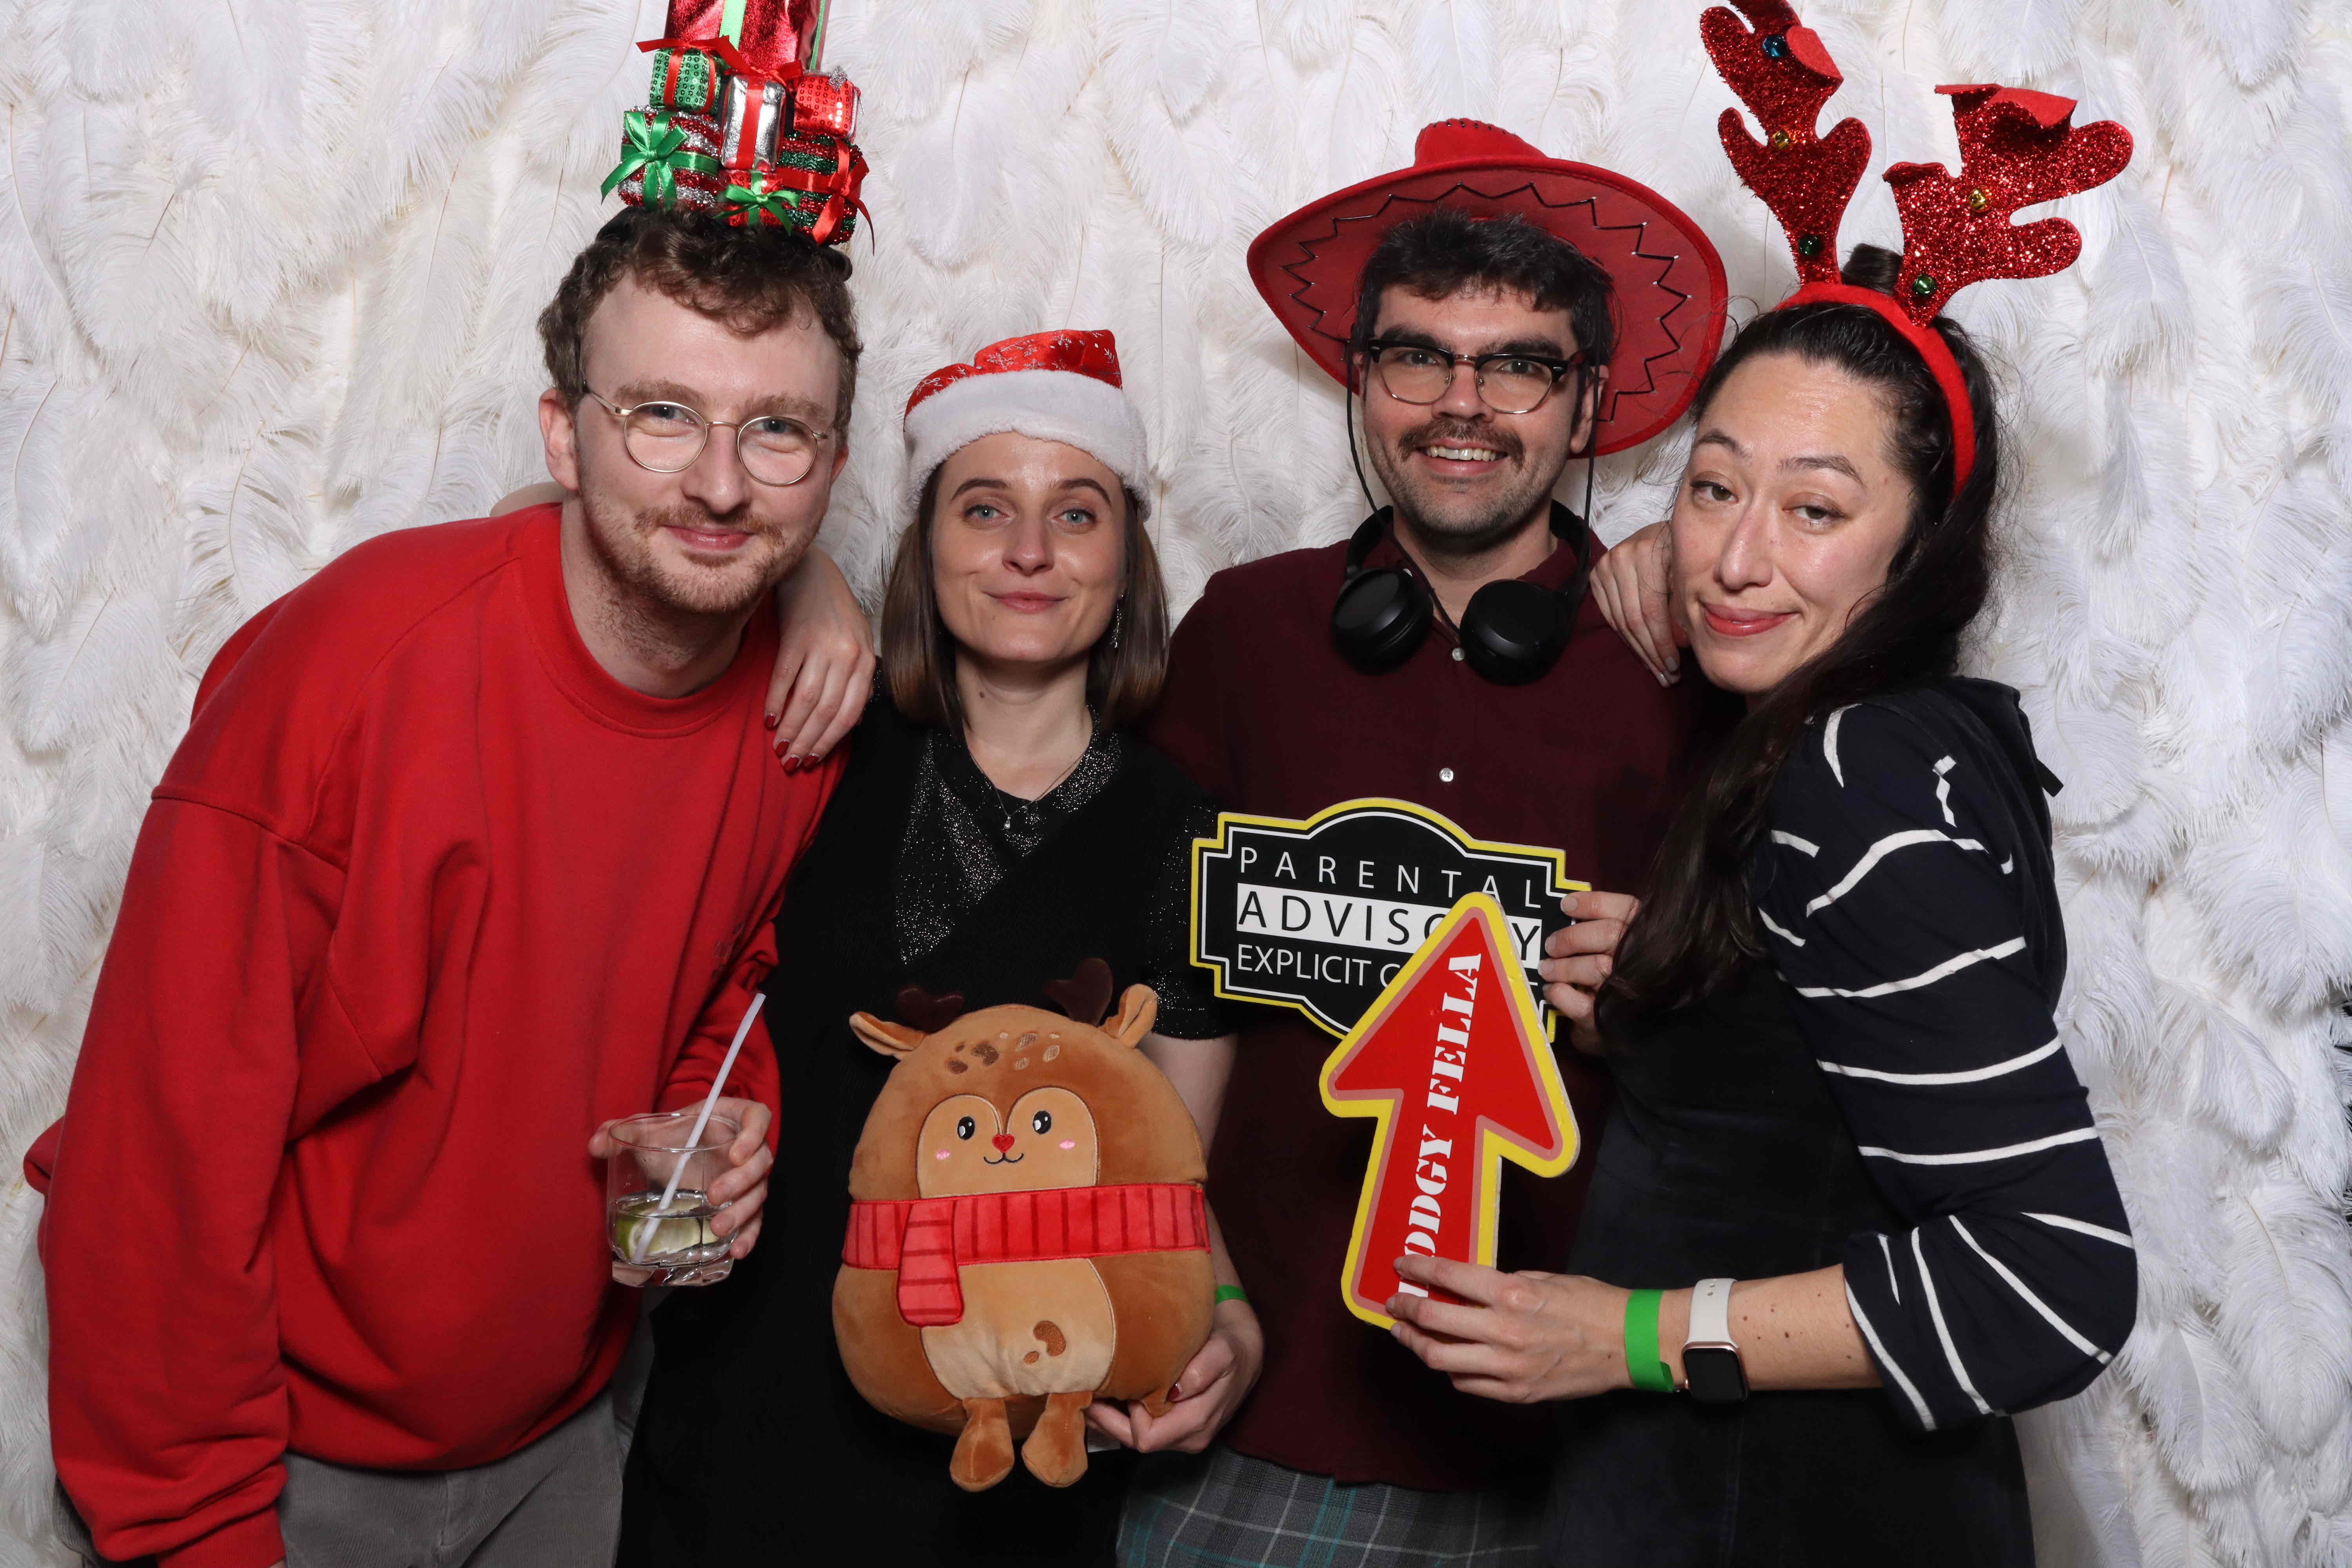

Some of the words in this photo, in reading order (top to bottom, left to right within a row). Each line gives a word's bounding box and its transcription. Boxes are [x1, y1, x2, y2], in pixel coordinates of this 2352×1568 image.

[1240, 846, 1541, 909] PARENTAL
[1238, 891, 1540, 961] ADVISY
[1238, 944, 1372, 986] EXPLICIT
[1427, 953, 1481, 1115] FELLA
